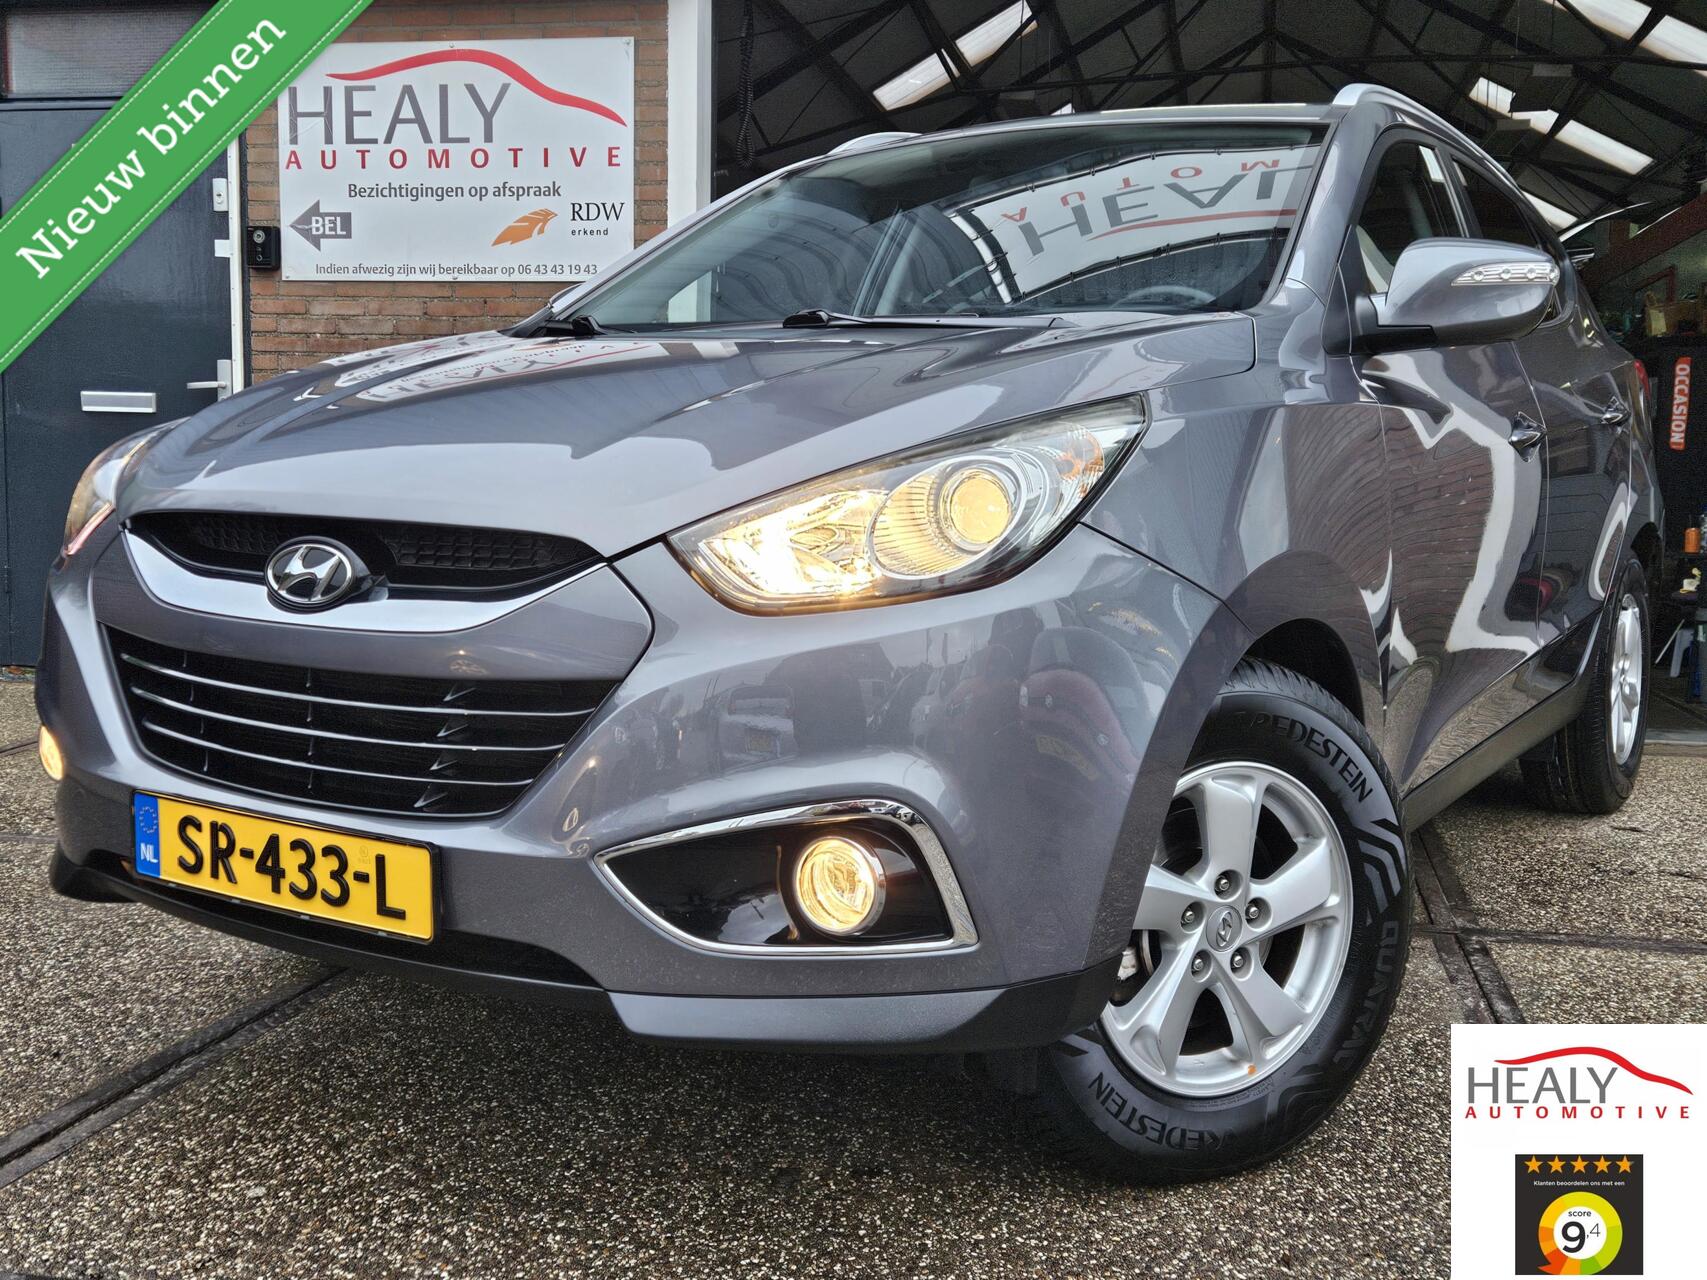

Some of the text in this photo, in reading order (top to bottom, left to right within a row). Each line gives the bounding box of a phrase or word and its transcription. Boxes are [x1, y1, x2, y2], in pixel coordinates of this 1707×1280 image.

[287, 82, 512, 146] HEALY
[284, 146, 621, 170] AUTOMOTIVE
[348, 181, 562, 202] Bezichtigingen op afspraak
[570, 202, 625, 221] RDW
[311, 215, 347, 236] BEL
[571, 227, 609, 236] erkend
[315, 263, 598, 278] Indien afwezig zijn wij bereikbaar op 06 43 43 19 43
[1669, 363, 1690, 443] OCCASION
[1246, 710, 1374, 803] REDESTEIN
[140, 842, 159, 864] NL
[177, 814, 406, 921] SR-433-L
[1087, 1071, 1230, 1151] REDESTEIN
